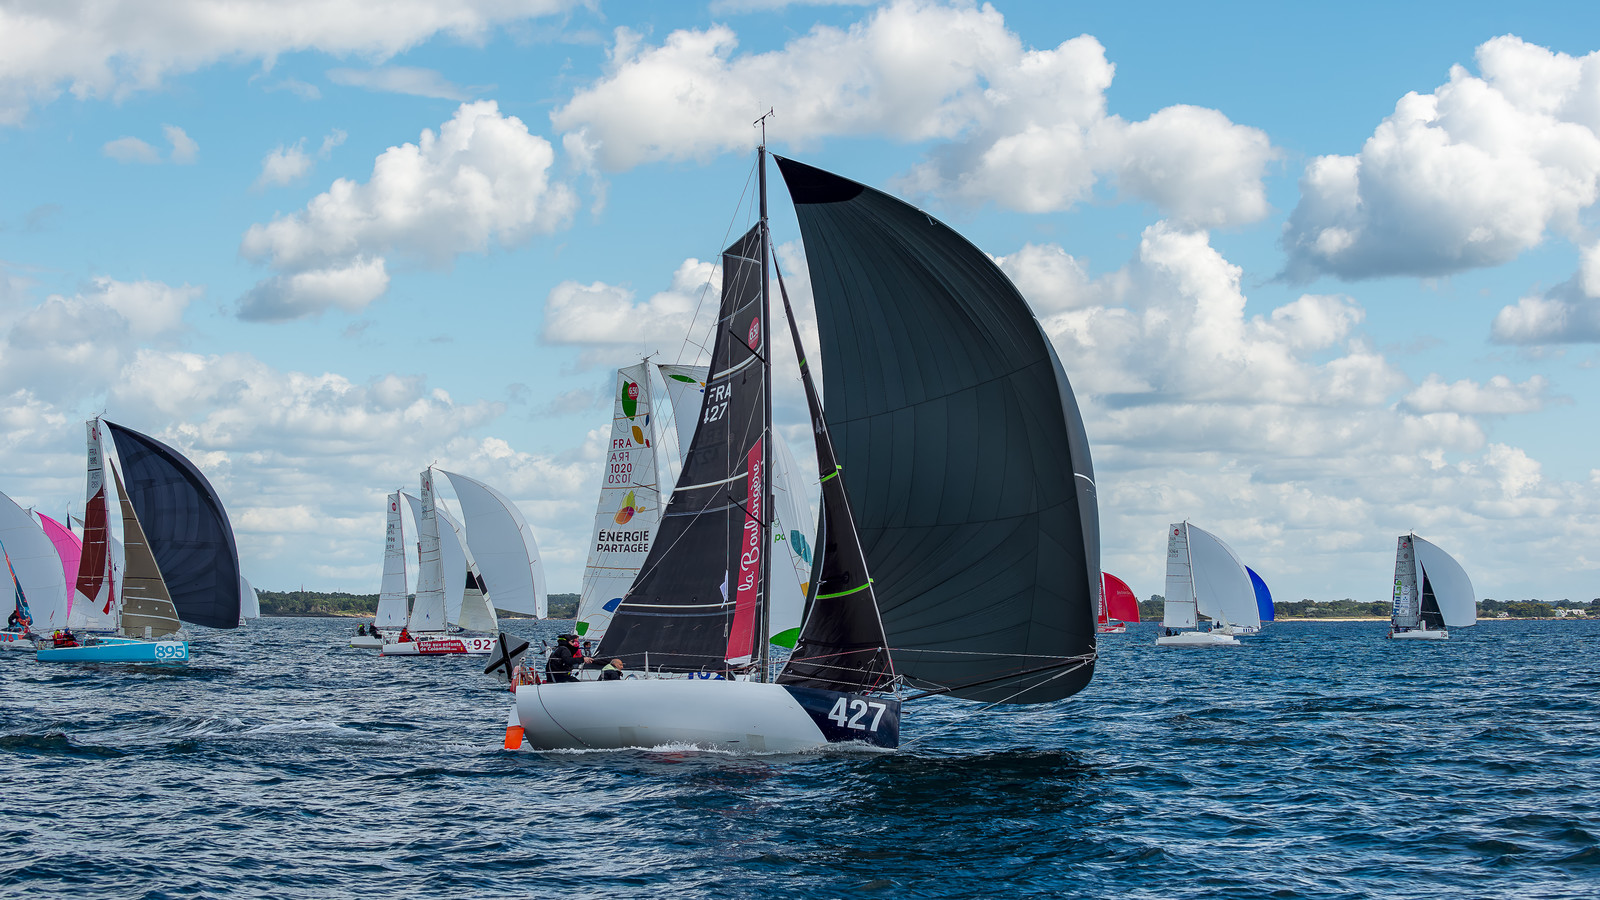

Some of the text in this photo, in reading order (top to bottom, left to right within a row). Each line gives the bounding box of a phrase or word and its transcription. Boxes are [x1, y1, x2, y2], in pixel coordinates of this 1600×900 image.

[708, 382, 732, 405] FRA
[613, 438, 633, 449] FRA
[611, 463, 633, 474] 1020
[598, 528, 650, 542] ÉNERGIE
[596, 542, 650, 553] PARTAGÉE
[737, 571, 755, 592] la
[155, 644, 185, 659] 895
[827, 696, 887, 732] 427
